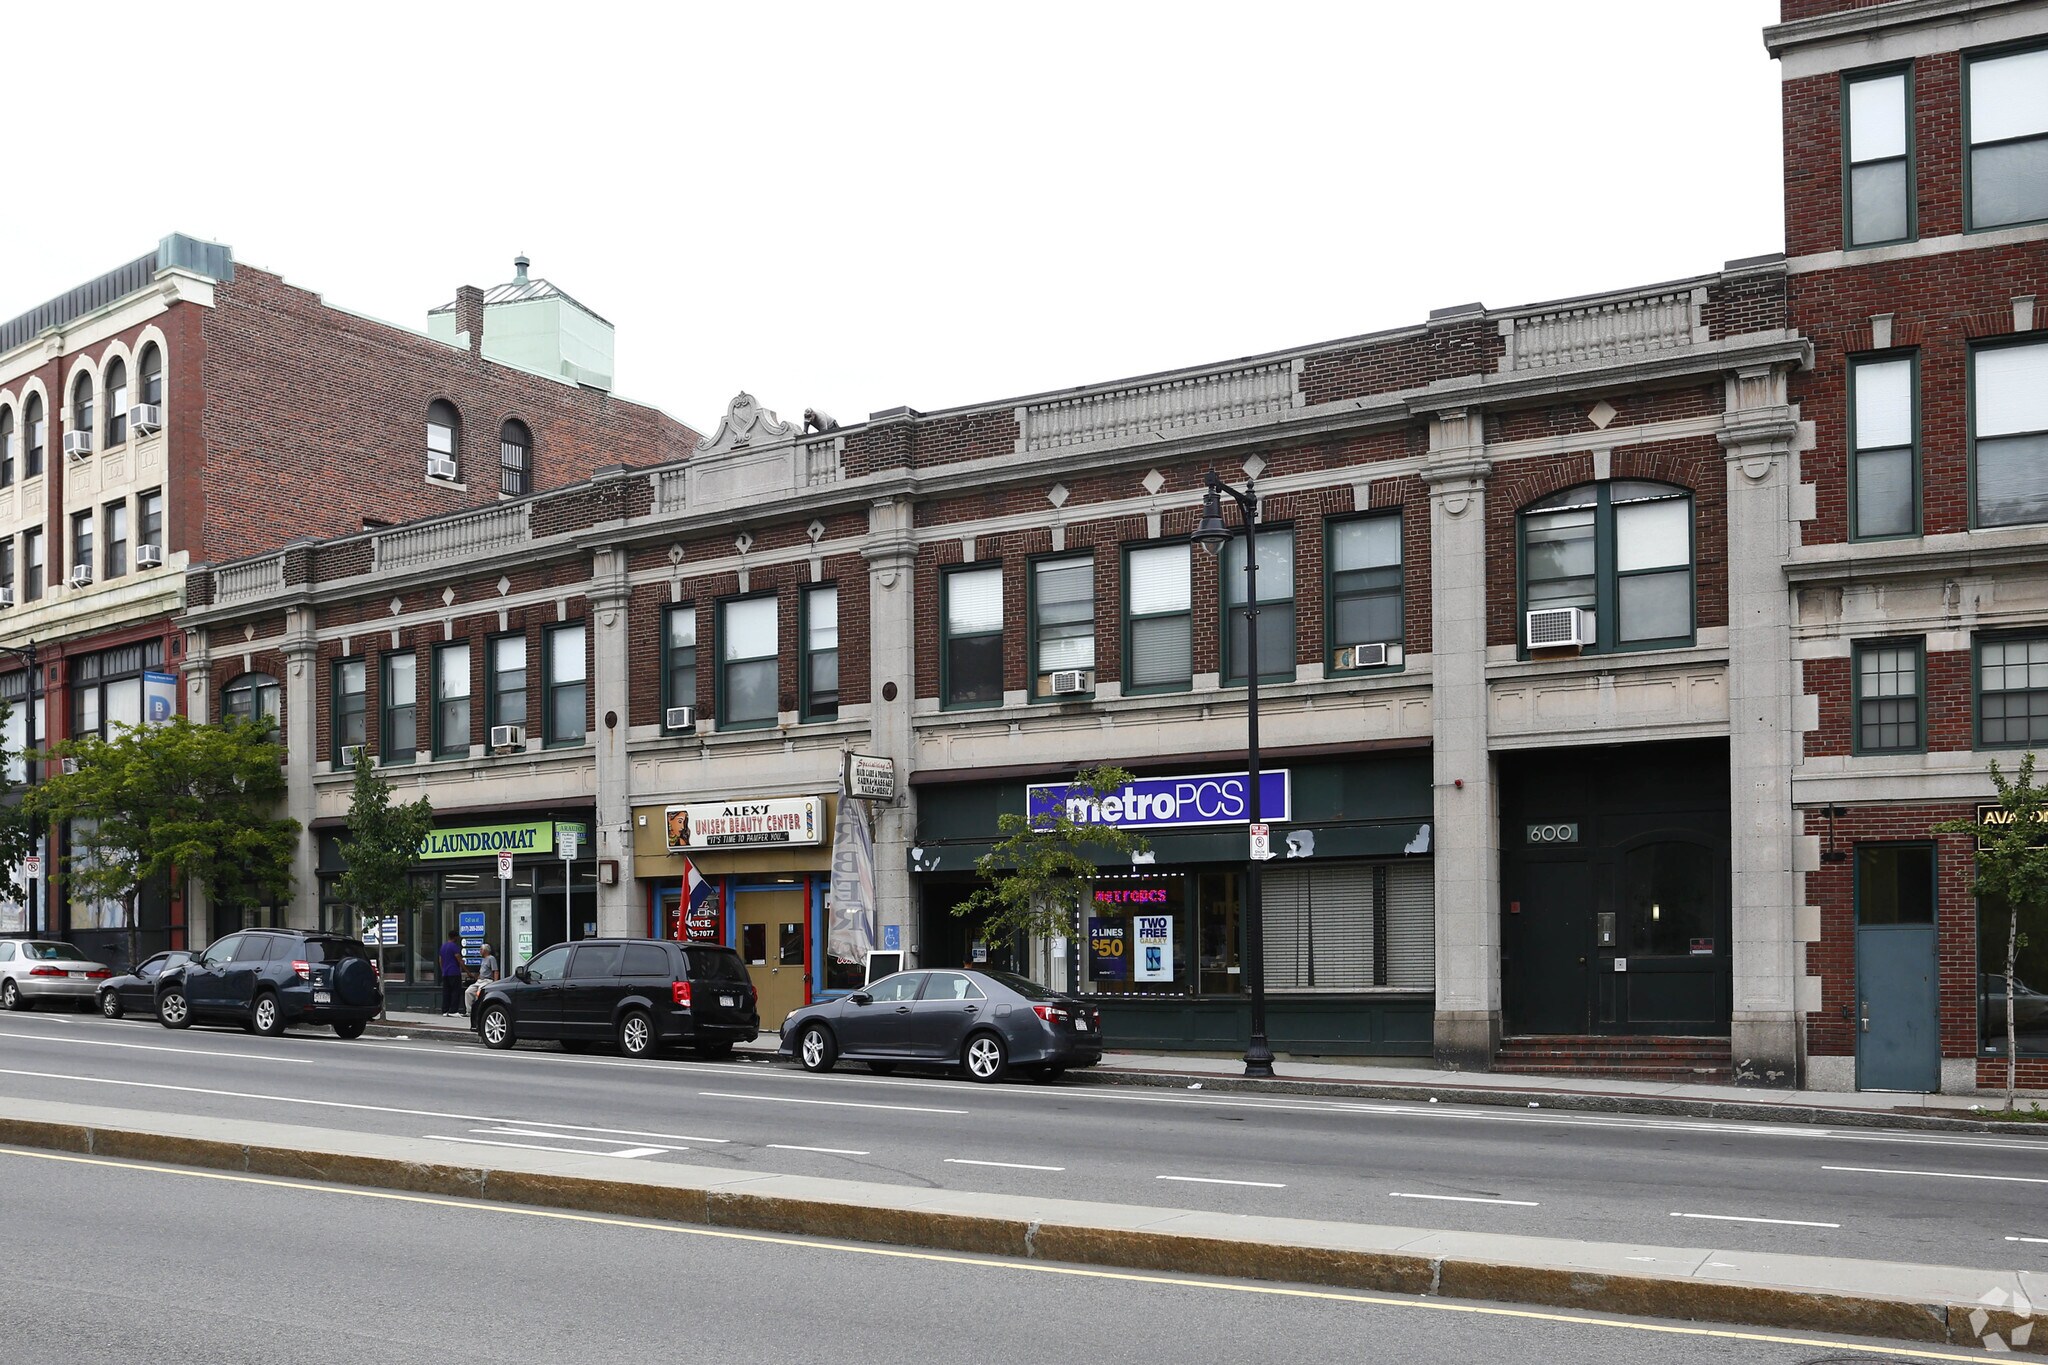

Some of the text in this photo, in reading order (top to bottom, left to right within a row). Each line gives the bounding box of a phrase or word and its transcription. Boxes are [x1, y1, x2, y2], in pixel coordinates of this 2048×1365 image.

[1066, 779, 1244, 823] metroPCS
[722, 804, 770, 816] ALEX'S
[695, 813, 801, 836] UNISEX BEAUTY CENTER
[723, 835, 736, 843] TIME
[747, 834, 769, 842] PAMPER
[1531, 825, 1571, 841] 600
[431, 829, 536, 853] LAUNDROMAT
[1139, 917, 1167, 928] TWO
[1099, 928, 1123, 936] LINES
[1140, 928, 1167, 938] FREE
[1092, 938, 1123, 956] $50
